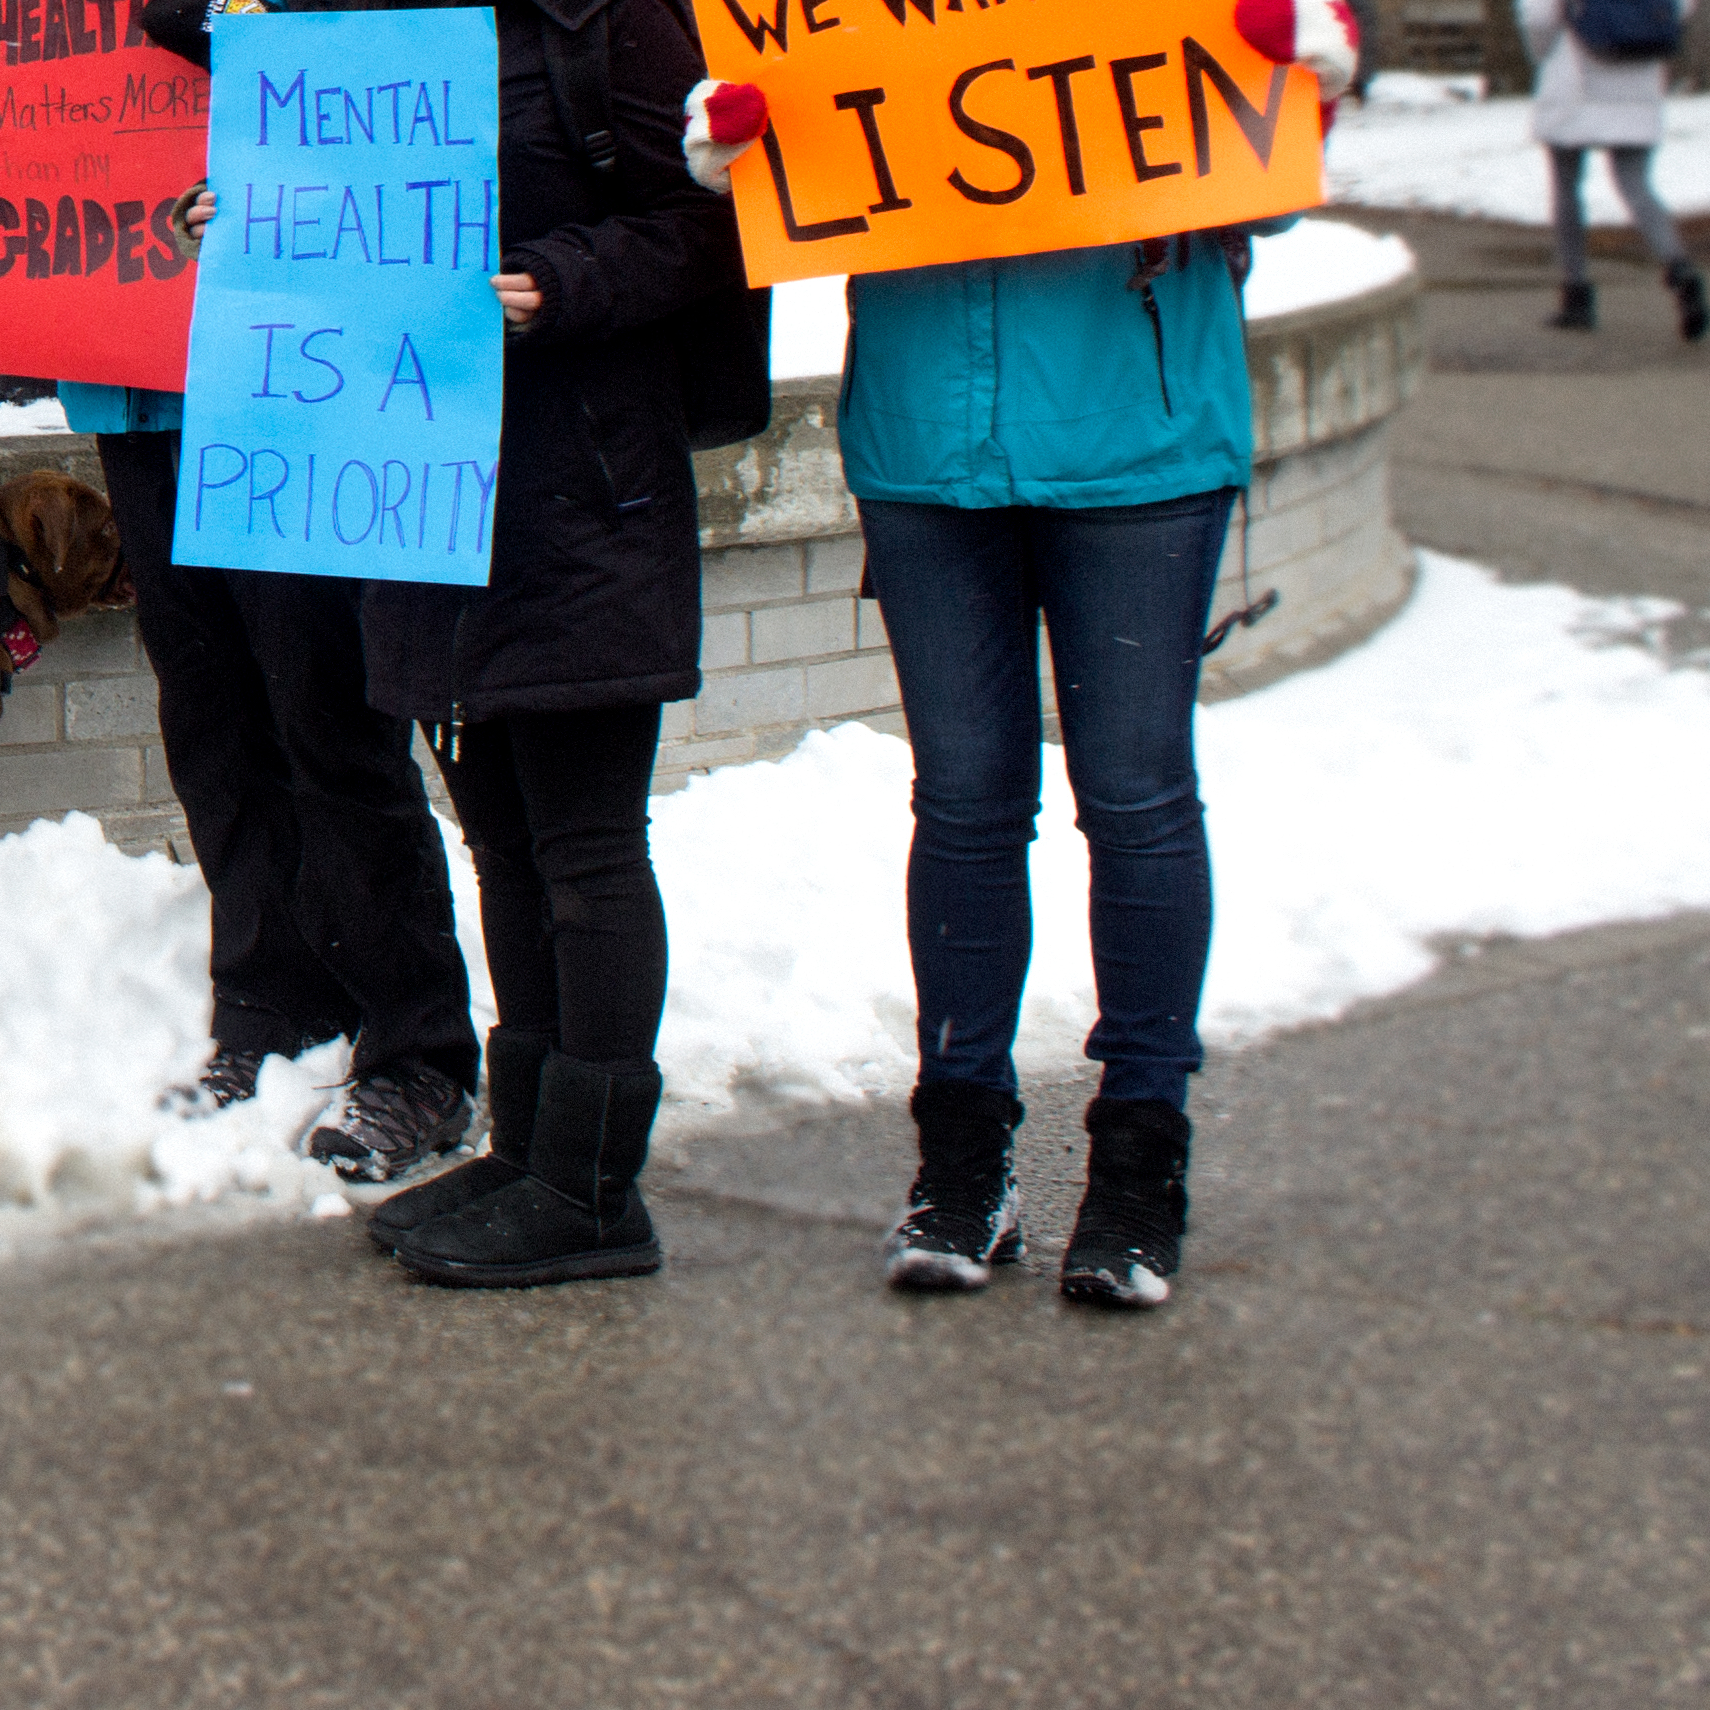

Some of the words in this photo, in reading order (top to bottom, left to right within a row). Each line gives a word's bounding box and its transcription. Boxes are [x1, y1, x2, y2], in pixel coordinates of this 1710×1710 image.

[119, 73, 210, 125] MORE
[256, 68, 474, 146] MENTAL
[760, 35, 1288, 242] LISTEN
[243, 177, 493, 272] HEALTH
[249, 324, 344, 403] IS
[378, 332, 434, 421] A
[195, 443, 499, 554] PRIORITY
